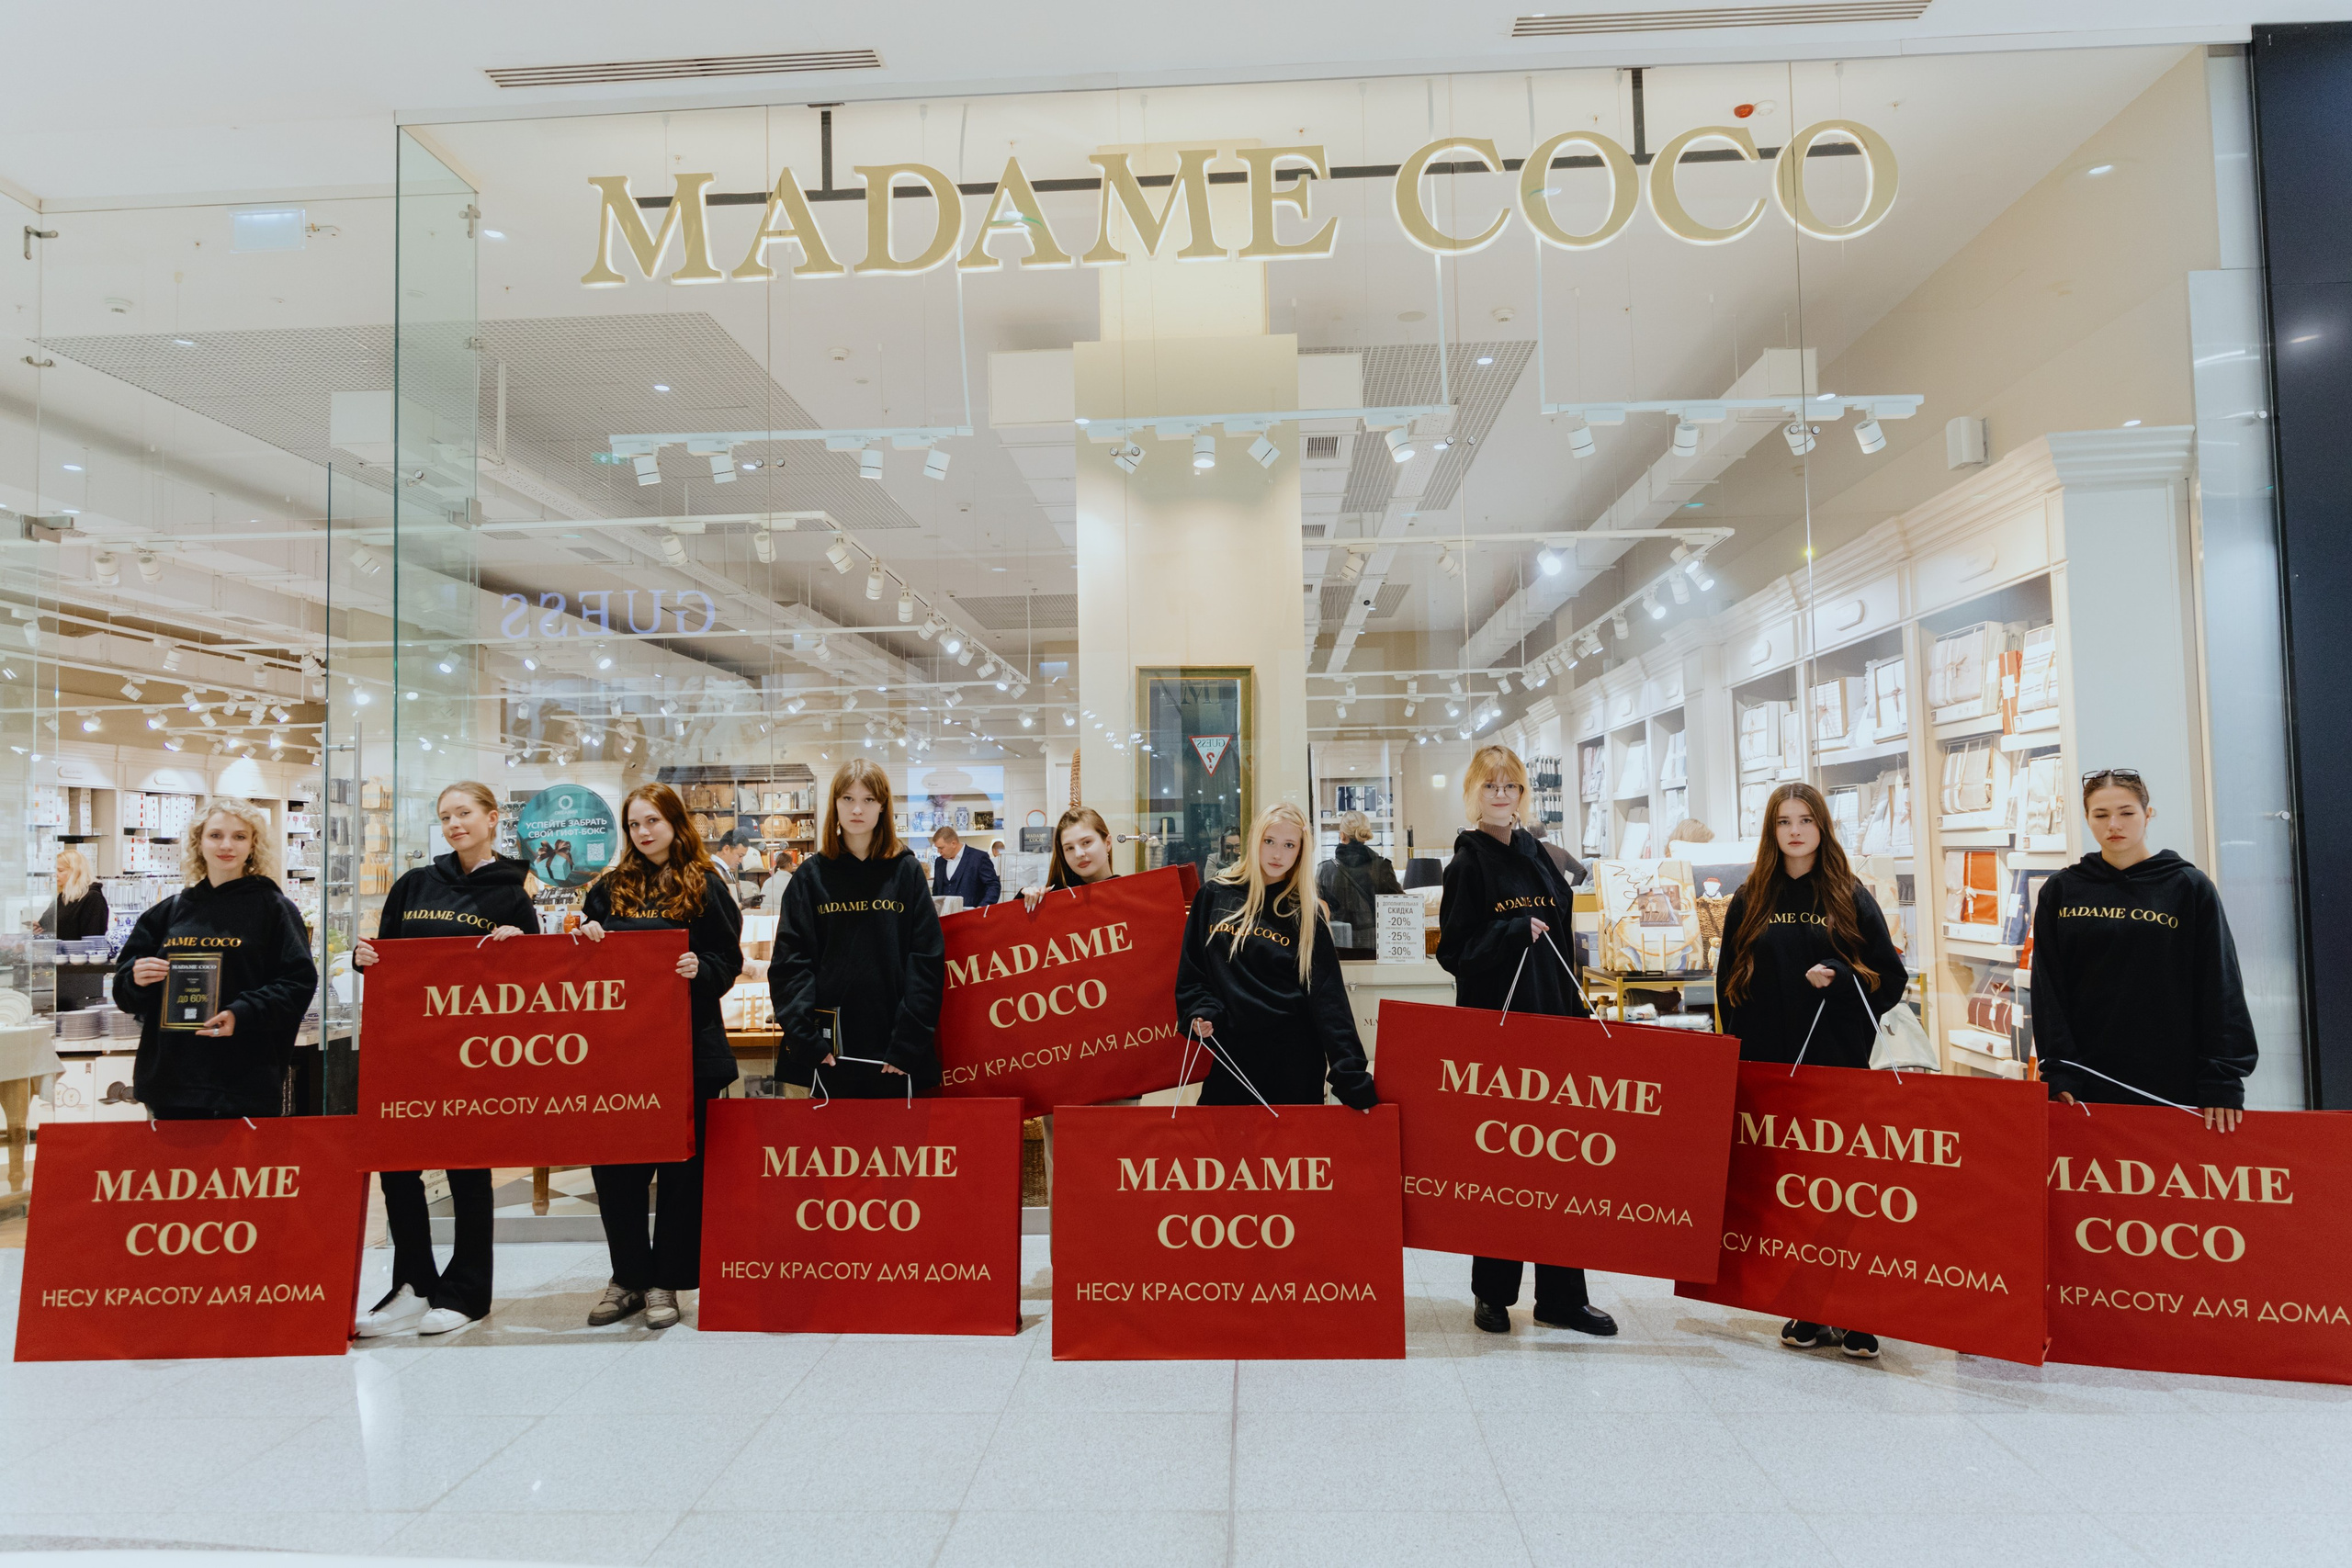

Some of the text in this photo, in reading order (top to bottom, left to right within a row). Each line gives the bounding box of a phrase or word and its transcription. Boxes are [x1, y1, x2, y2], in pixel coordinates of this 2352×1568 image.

[581, 119, 1899, 288] MADAME COCO
[526, 818, 607, 829] УСПЕЙТЕ ЗАБРАТЬ
[528, 827, 605, 839] СВОЙ ГИФТ-БОКС
[402, 909, 497, 933] MADAME COCO
[1387, 907, 1413, 915] СКИДКА
[1388, 917, 1411, 926] -20%
[2058, 907, 2178, 929] MADAME COCO
[200, 937, 242, 947] COCO
[1253, 927, 1290, 946] COCO
[1388, 931, 1411, 941] -25%
[1388, 946, 1411, 955] -30%
[945, 921, 1133, 989] MADAME
[423, 979, 627, 1017] MADAME
[989, 978, 1107, 1029] COCO
[459, 1033, 589, 1068] COCO
[939, 1064, 978, 1087] ЕСУ
[985, 1043, 1072, 1077] КРАСОТУ
[1080, 1034, 1118, 1059] ДЛЯ
[1438, 1058, 1662, 1116] MADAME
[381, 1093, 661, 1119] НЕСУ КРАСОТУ ДЛЯ ДОМА
[1475, 1120, 1617, 1167] COCO
[1737, 1111, 1962, 1168] MADAME
[761, 1146, 958, 1178] MADAME
[1117, 1157, 1333, 1191] MADAME
[92, 1166, 300, 1202] MADAME
[1401, 1175, 1693, 1227] ЕСУ КРАСОТУ ДЛЯ ДОМА
[1776, 1173, 1917, 1223] COCO
[796, 1199, 921, 1232] COCO
[1158, 1214, 1295, 1249] COCO
[126, 1221, 257, 1256] COCO
[2075, 1217, 2245, 1263] COCO
[722, 1261, 991, 1282] НЕСУ КРАСОТУ ДЛЯ ДОМА
[1720, 1232, 2008, 1295] СУ КРАСОТУ ДЛЯ ДОМА
[42, 1284, 325, 1307] НЕСУ КРАСОТУ ДЛЯ ДОМА
[1077, 1282, 1376, 1303] НЕСУ КРАСОТУ ДЛЯ ДОМА
[2060, 1285, 2351, 1325] КРАСОТУ ДЛЯ ДОМА
